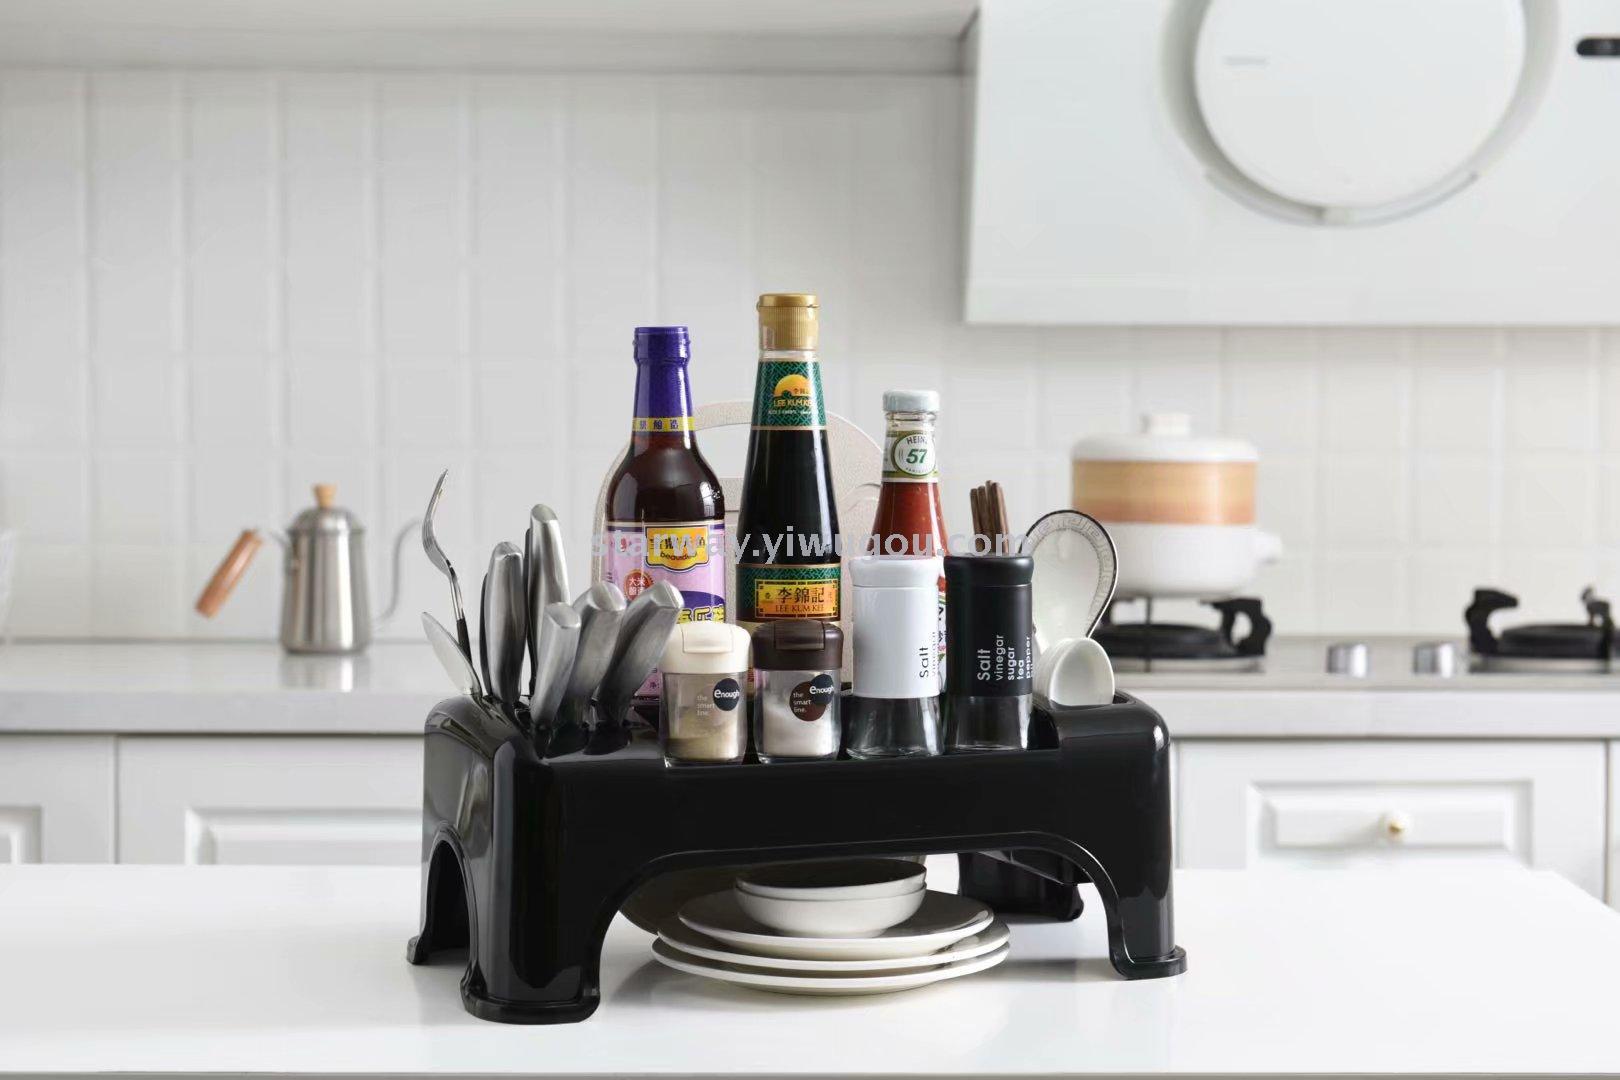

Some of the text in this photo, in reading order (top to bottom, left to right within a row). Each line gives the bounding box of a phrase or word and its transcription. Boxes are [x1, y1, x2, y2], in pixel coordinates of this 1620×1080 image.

[773, 399, 787, 407] LEE
[905, 448, 928, 464] 57
[775, 586, 825, 604] 李錦記
[775, 604, 825, 613] LEE KUM KEE
[918, 646, 930, 679] Salt
[977, 648, 991, 681] Salt
[994, 634, 1006, 681] vinegar
[1007, 646, 1018, 681] sugar
[1016, 659, 1025, 680] tea
[713, 688, 740, 700] enough
[792, 691, 804, 699] the
